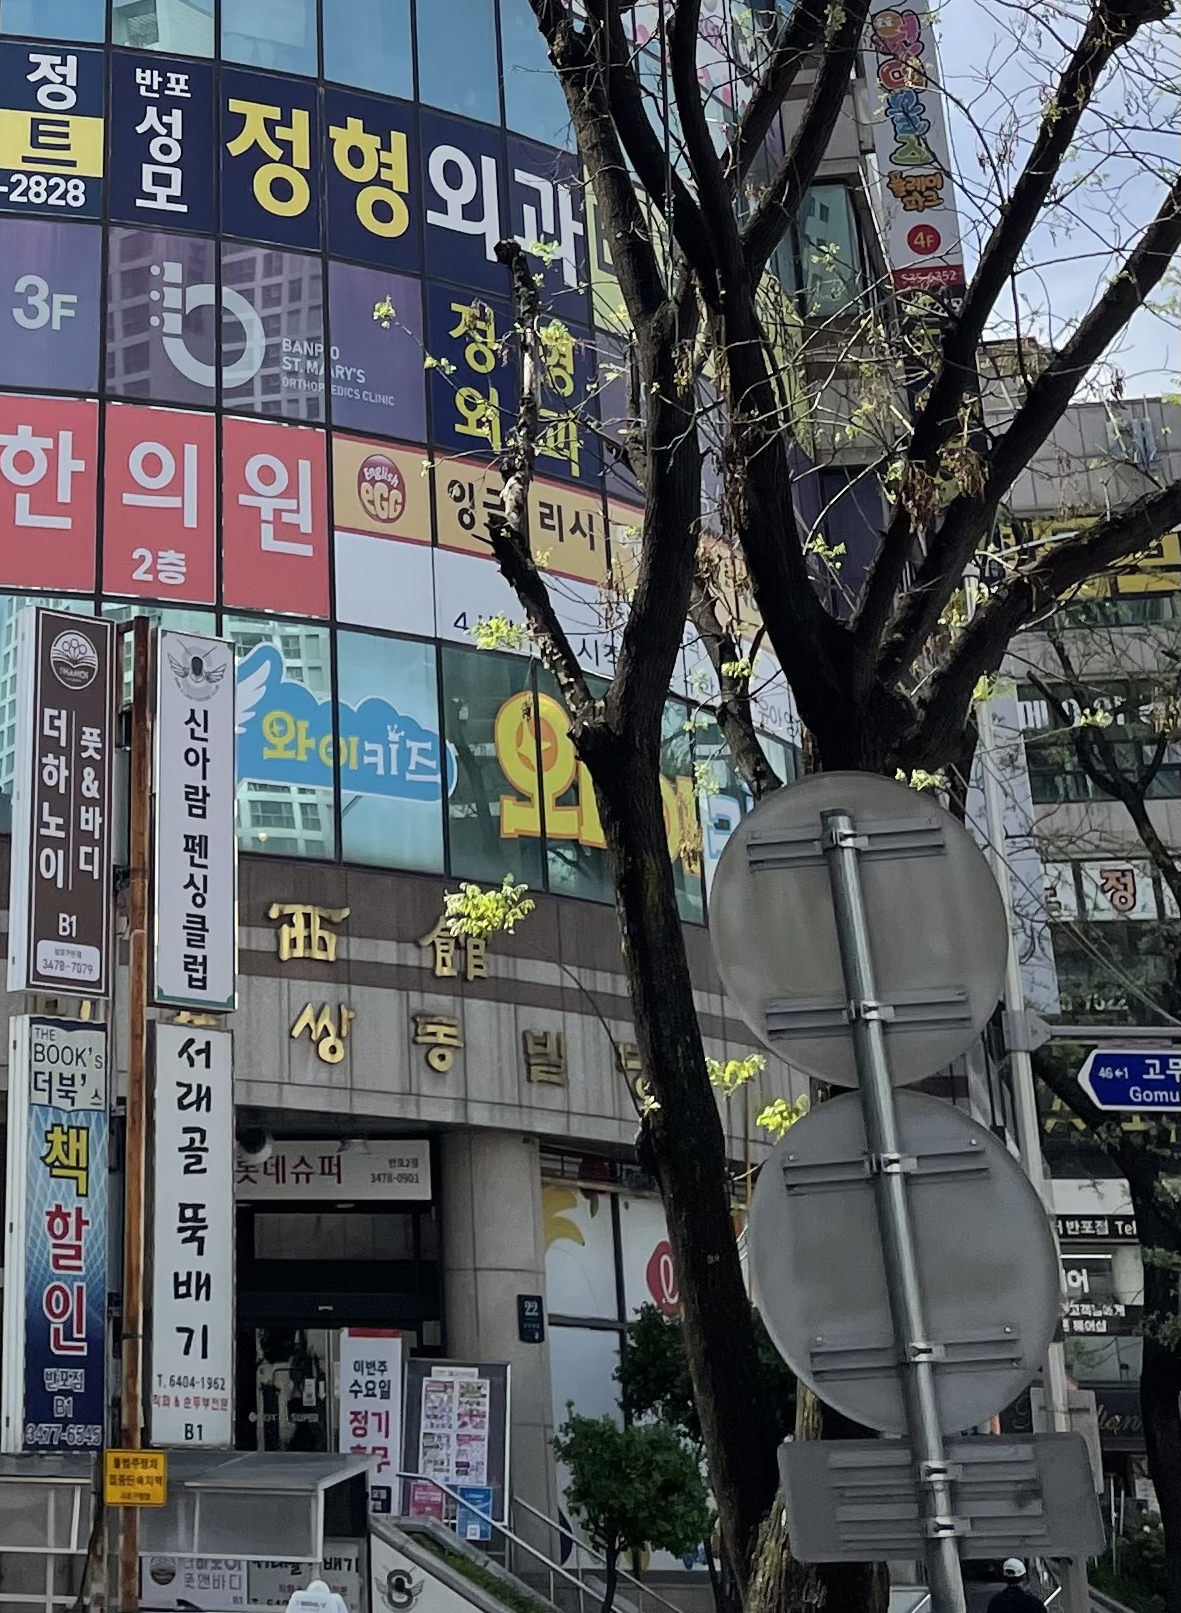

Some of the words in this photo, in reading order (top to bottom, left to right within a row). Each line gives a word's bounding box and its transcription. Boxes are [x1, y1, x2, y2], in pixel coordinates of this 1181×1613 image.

[135, 67, 192, 99] 반포
[135, 105, 189, 215] 성모
[913, 229, 935, 248] 4F
[12, 273, 78, 332] 3F
[282, 337, 340, 360] BANPO
[362, 390, 395, 407] CLINIC
[131, 546, 188, 587] 2층
[262, 710, 442, 781] 와이키즈
[183, 707, 211, 821] 신아람
[38, 707, 70, 890] 더하노이
[57, 912, 78, 938] B1
[182, 832, 210, 991] 펜싱클럽
[34, 1027, 56, 1042] THE
[176, 1037, 212, 1175] 서래골
[172, 1201, 212, 1361] 뚝배기
[523, 1300, 540, 1317] 22
[348, 1378, 392, 1401] 수요일
[53, 1395, 74, 1418] B1
[184, 1422, 203, 1441] B1
[349, 1409, 391, 1440] 정기
